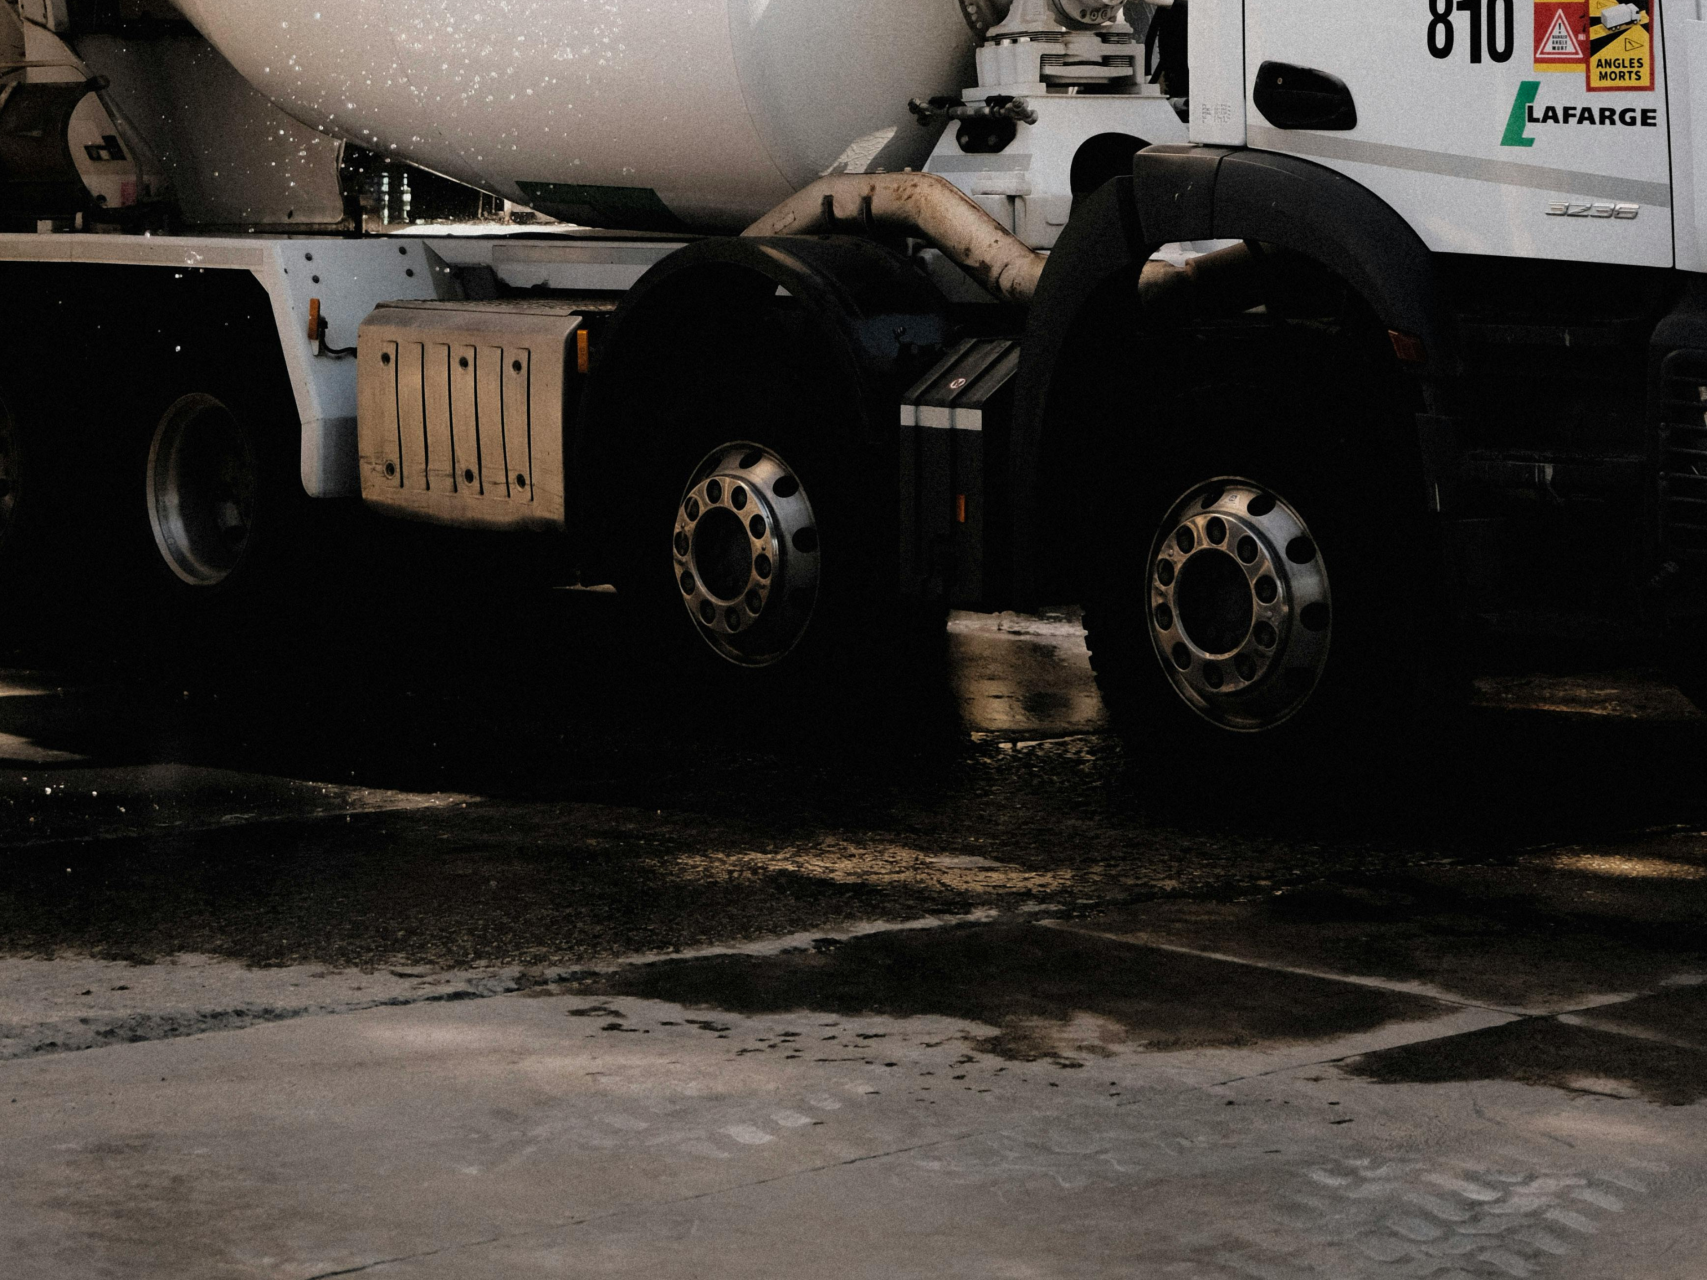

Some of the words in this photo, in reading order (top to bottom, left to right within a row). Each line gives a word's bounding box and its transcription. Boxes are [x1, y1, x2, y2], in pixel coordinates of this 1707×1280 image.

[1596, 57, 1644, 69] ANGLES
[1598, 70, 1642, 82] MORTS
[1527, 105, 1657, 127] LAFARGE
[1545, 202, 1640, 220] 3236
